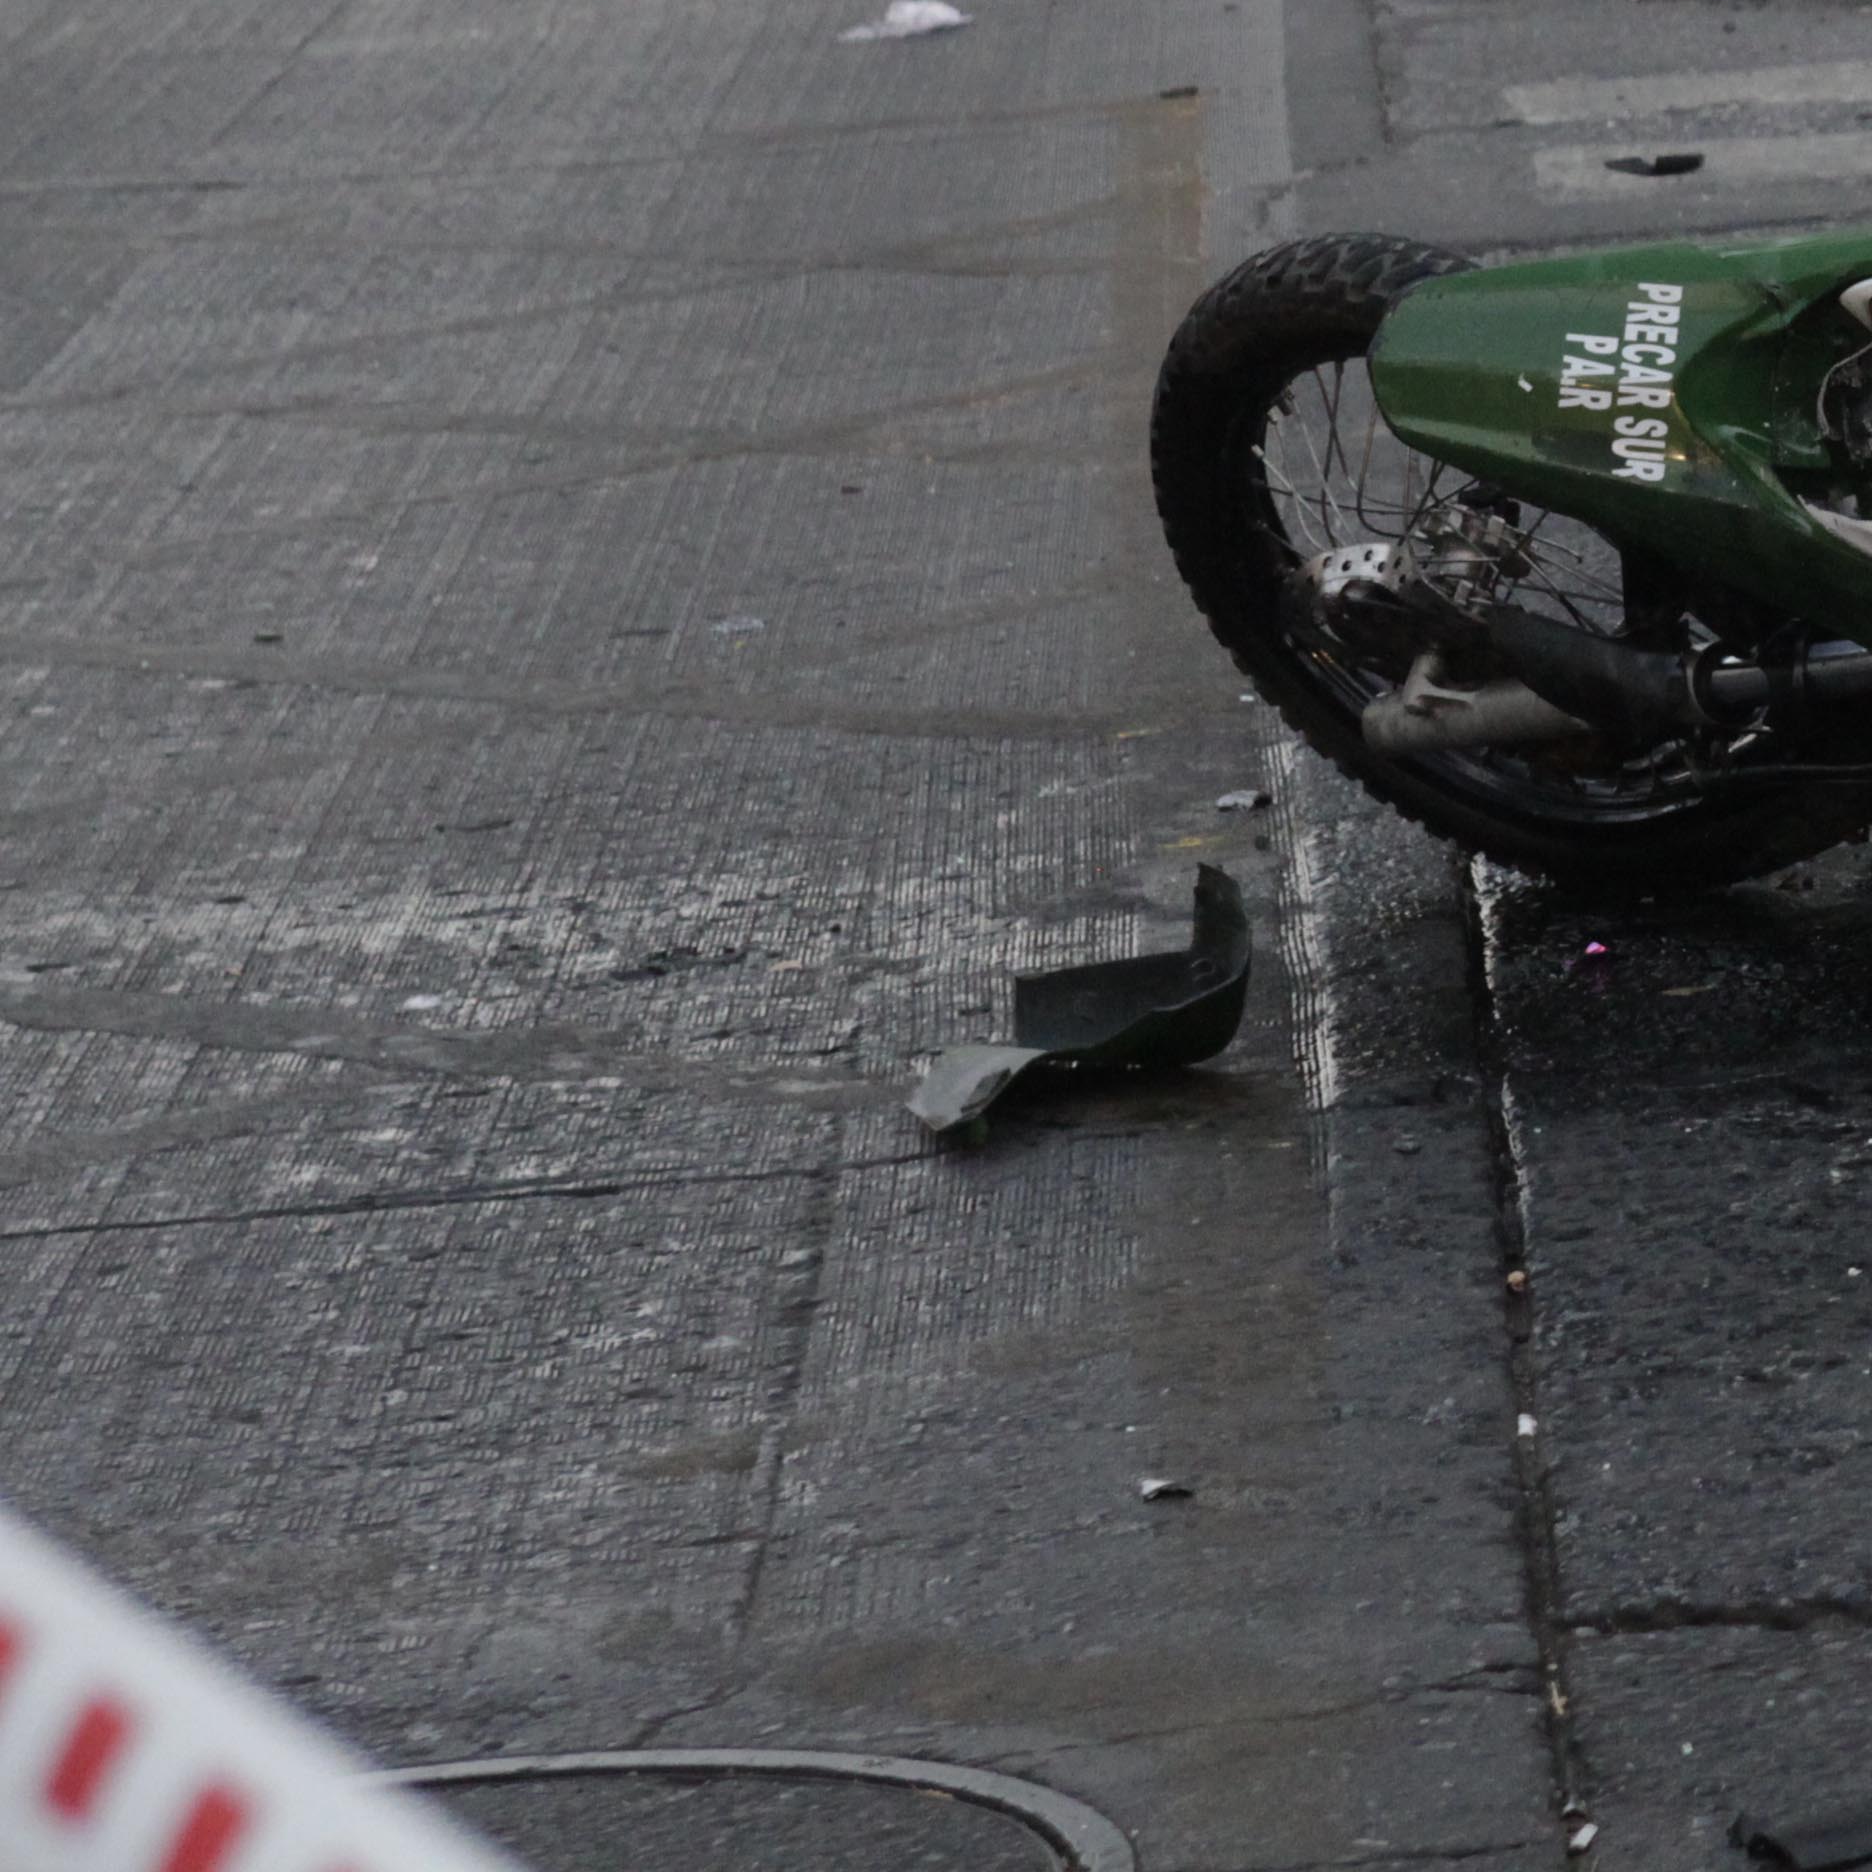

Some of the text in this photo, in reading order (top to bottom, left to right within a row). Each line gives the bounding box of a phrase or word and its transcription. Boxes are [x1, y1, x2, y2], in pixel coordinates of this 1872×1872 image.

[1557, 332, 1620, 411] PAR
[1611, 282, 1684, 482] PRECAR SUR
